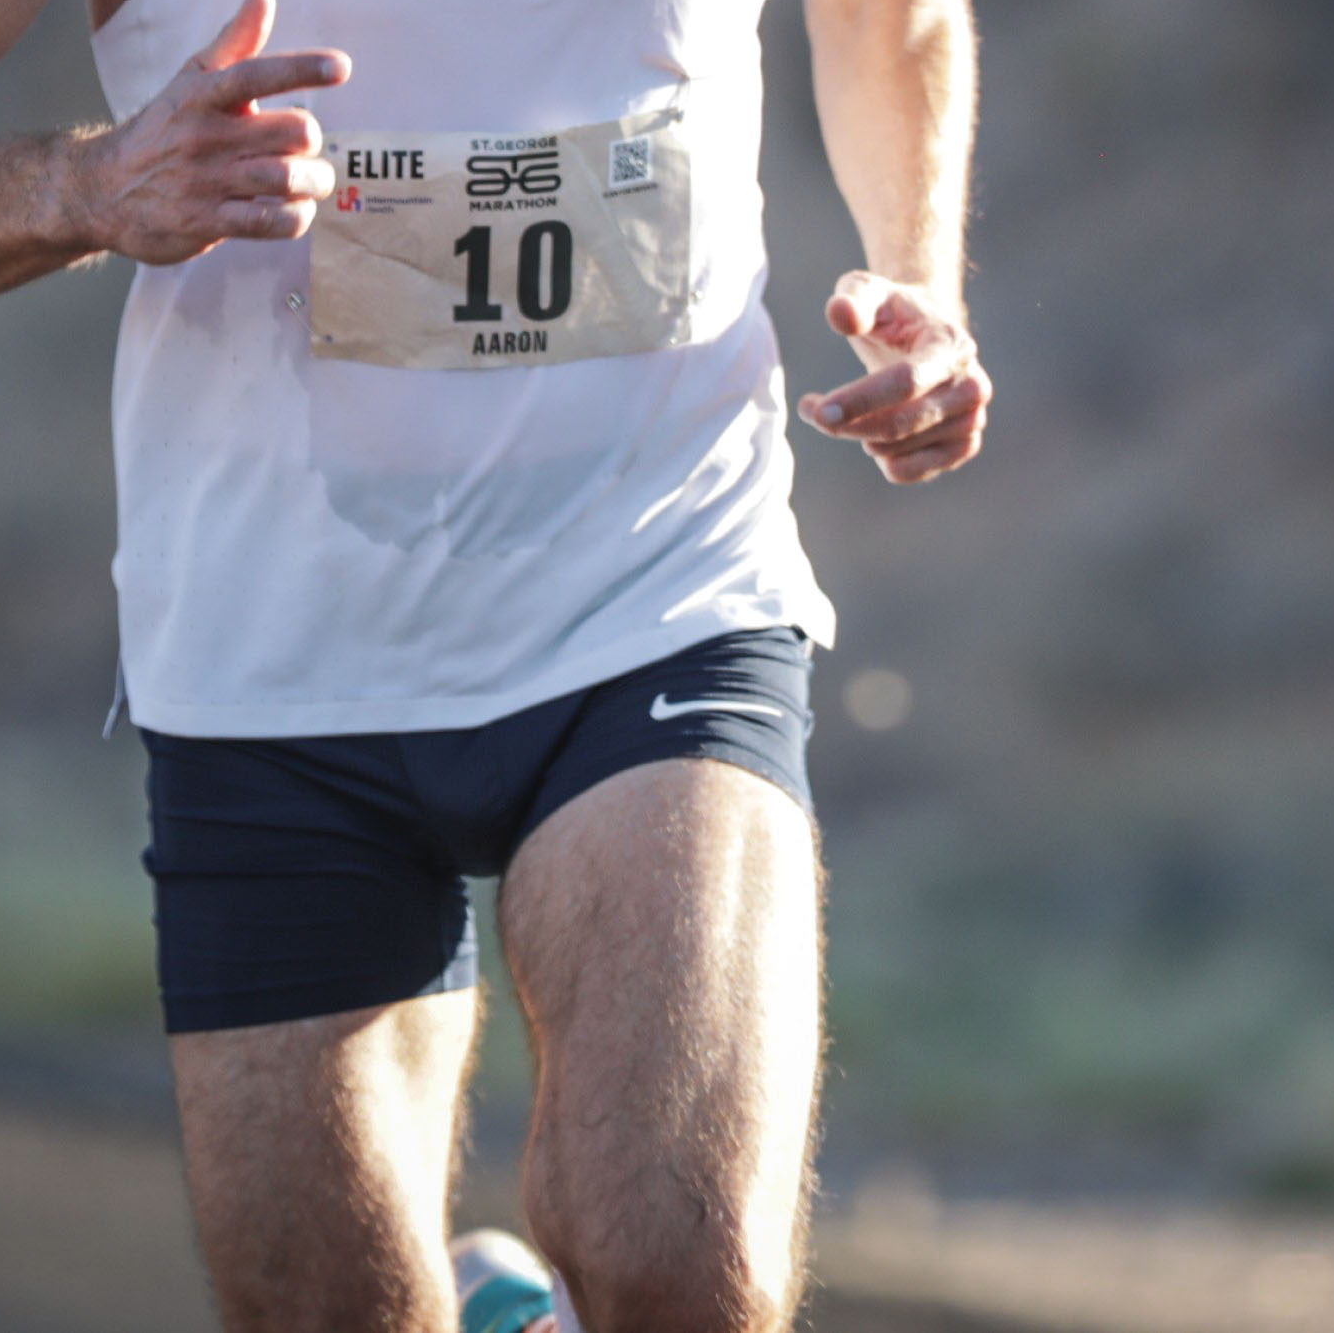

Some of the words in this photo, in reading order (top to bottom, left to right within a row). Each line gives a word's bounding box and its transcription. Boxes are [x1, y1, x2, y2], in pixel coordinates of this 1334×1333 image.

[347, 150, 424, 179] ELITE
[470, 197, 557, 212] MARATHON
[453, 220, 573, 322] 10
[472, 331, 547, 355] AARON
